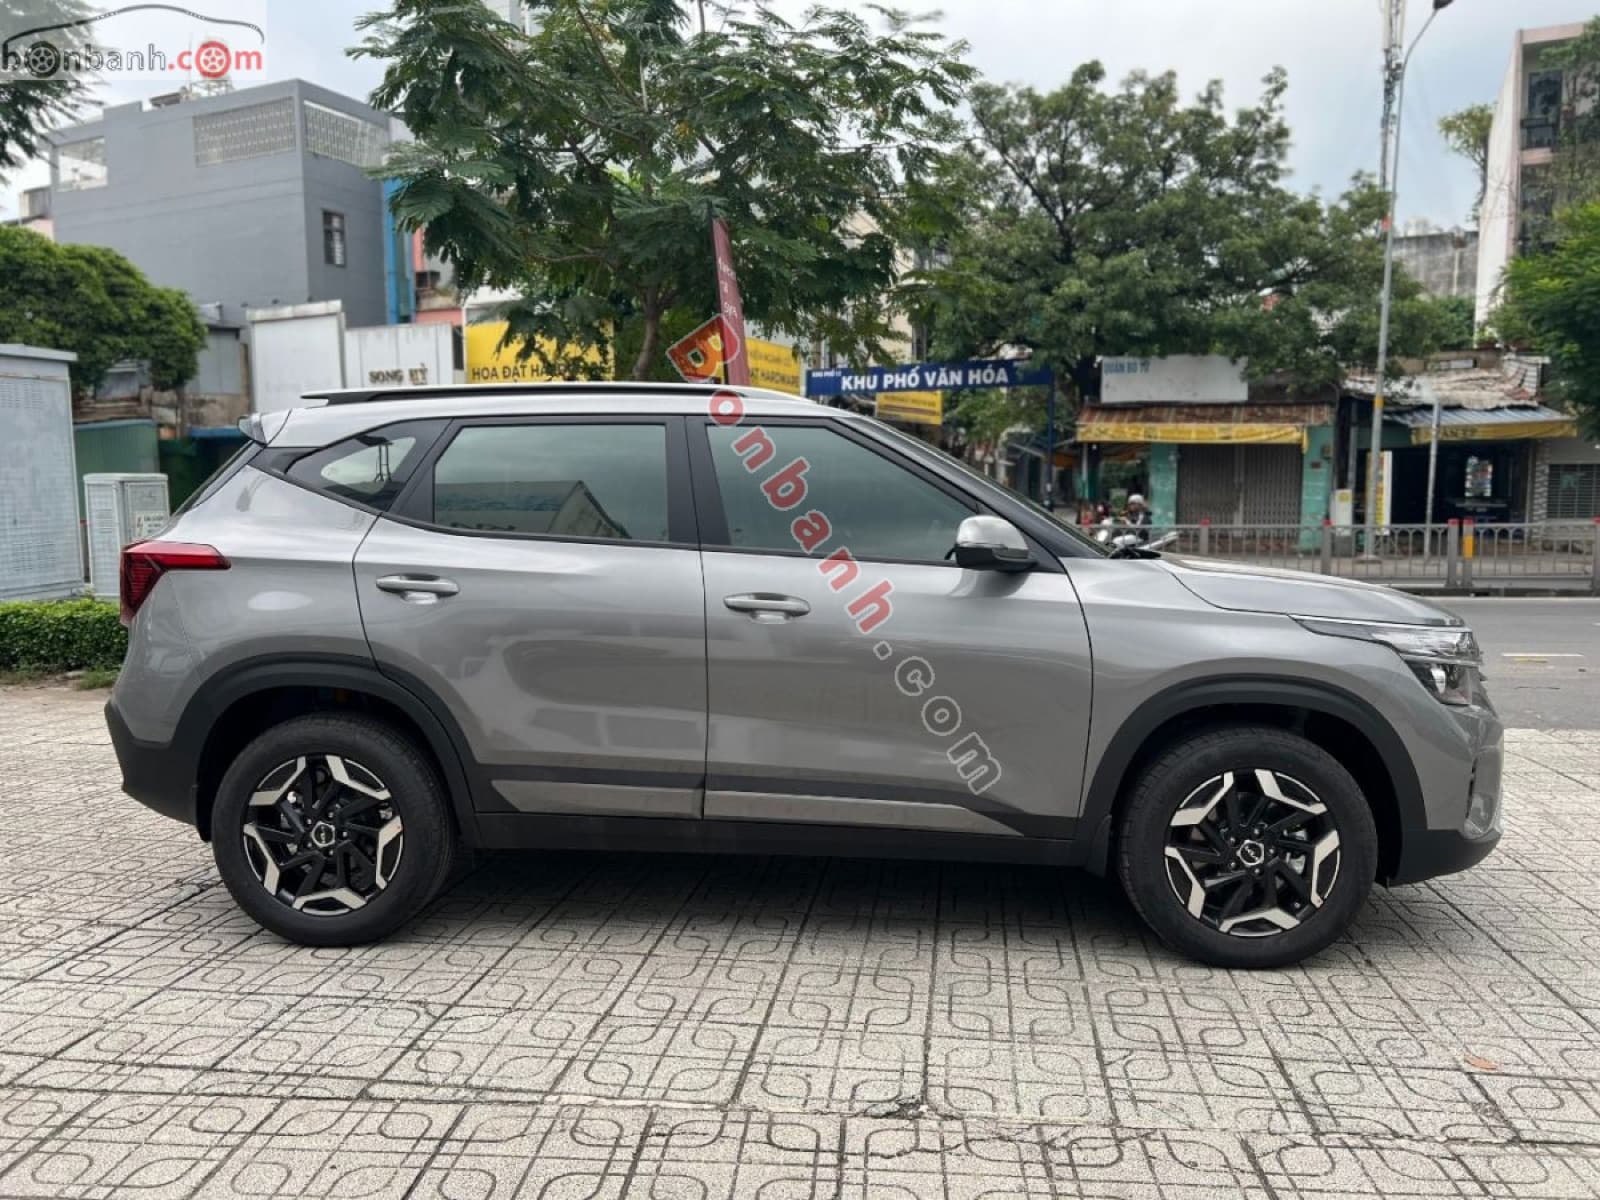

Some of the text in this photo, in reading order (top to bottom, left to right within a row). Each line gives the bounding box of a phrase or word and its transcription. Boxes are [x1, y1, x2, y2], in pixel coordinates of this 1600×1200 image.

[472, 366, 499, 380] HOA
[841, 365, 1009, 391] KHU PHỐ VĂN HÓA
